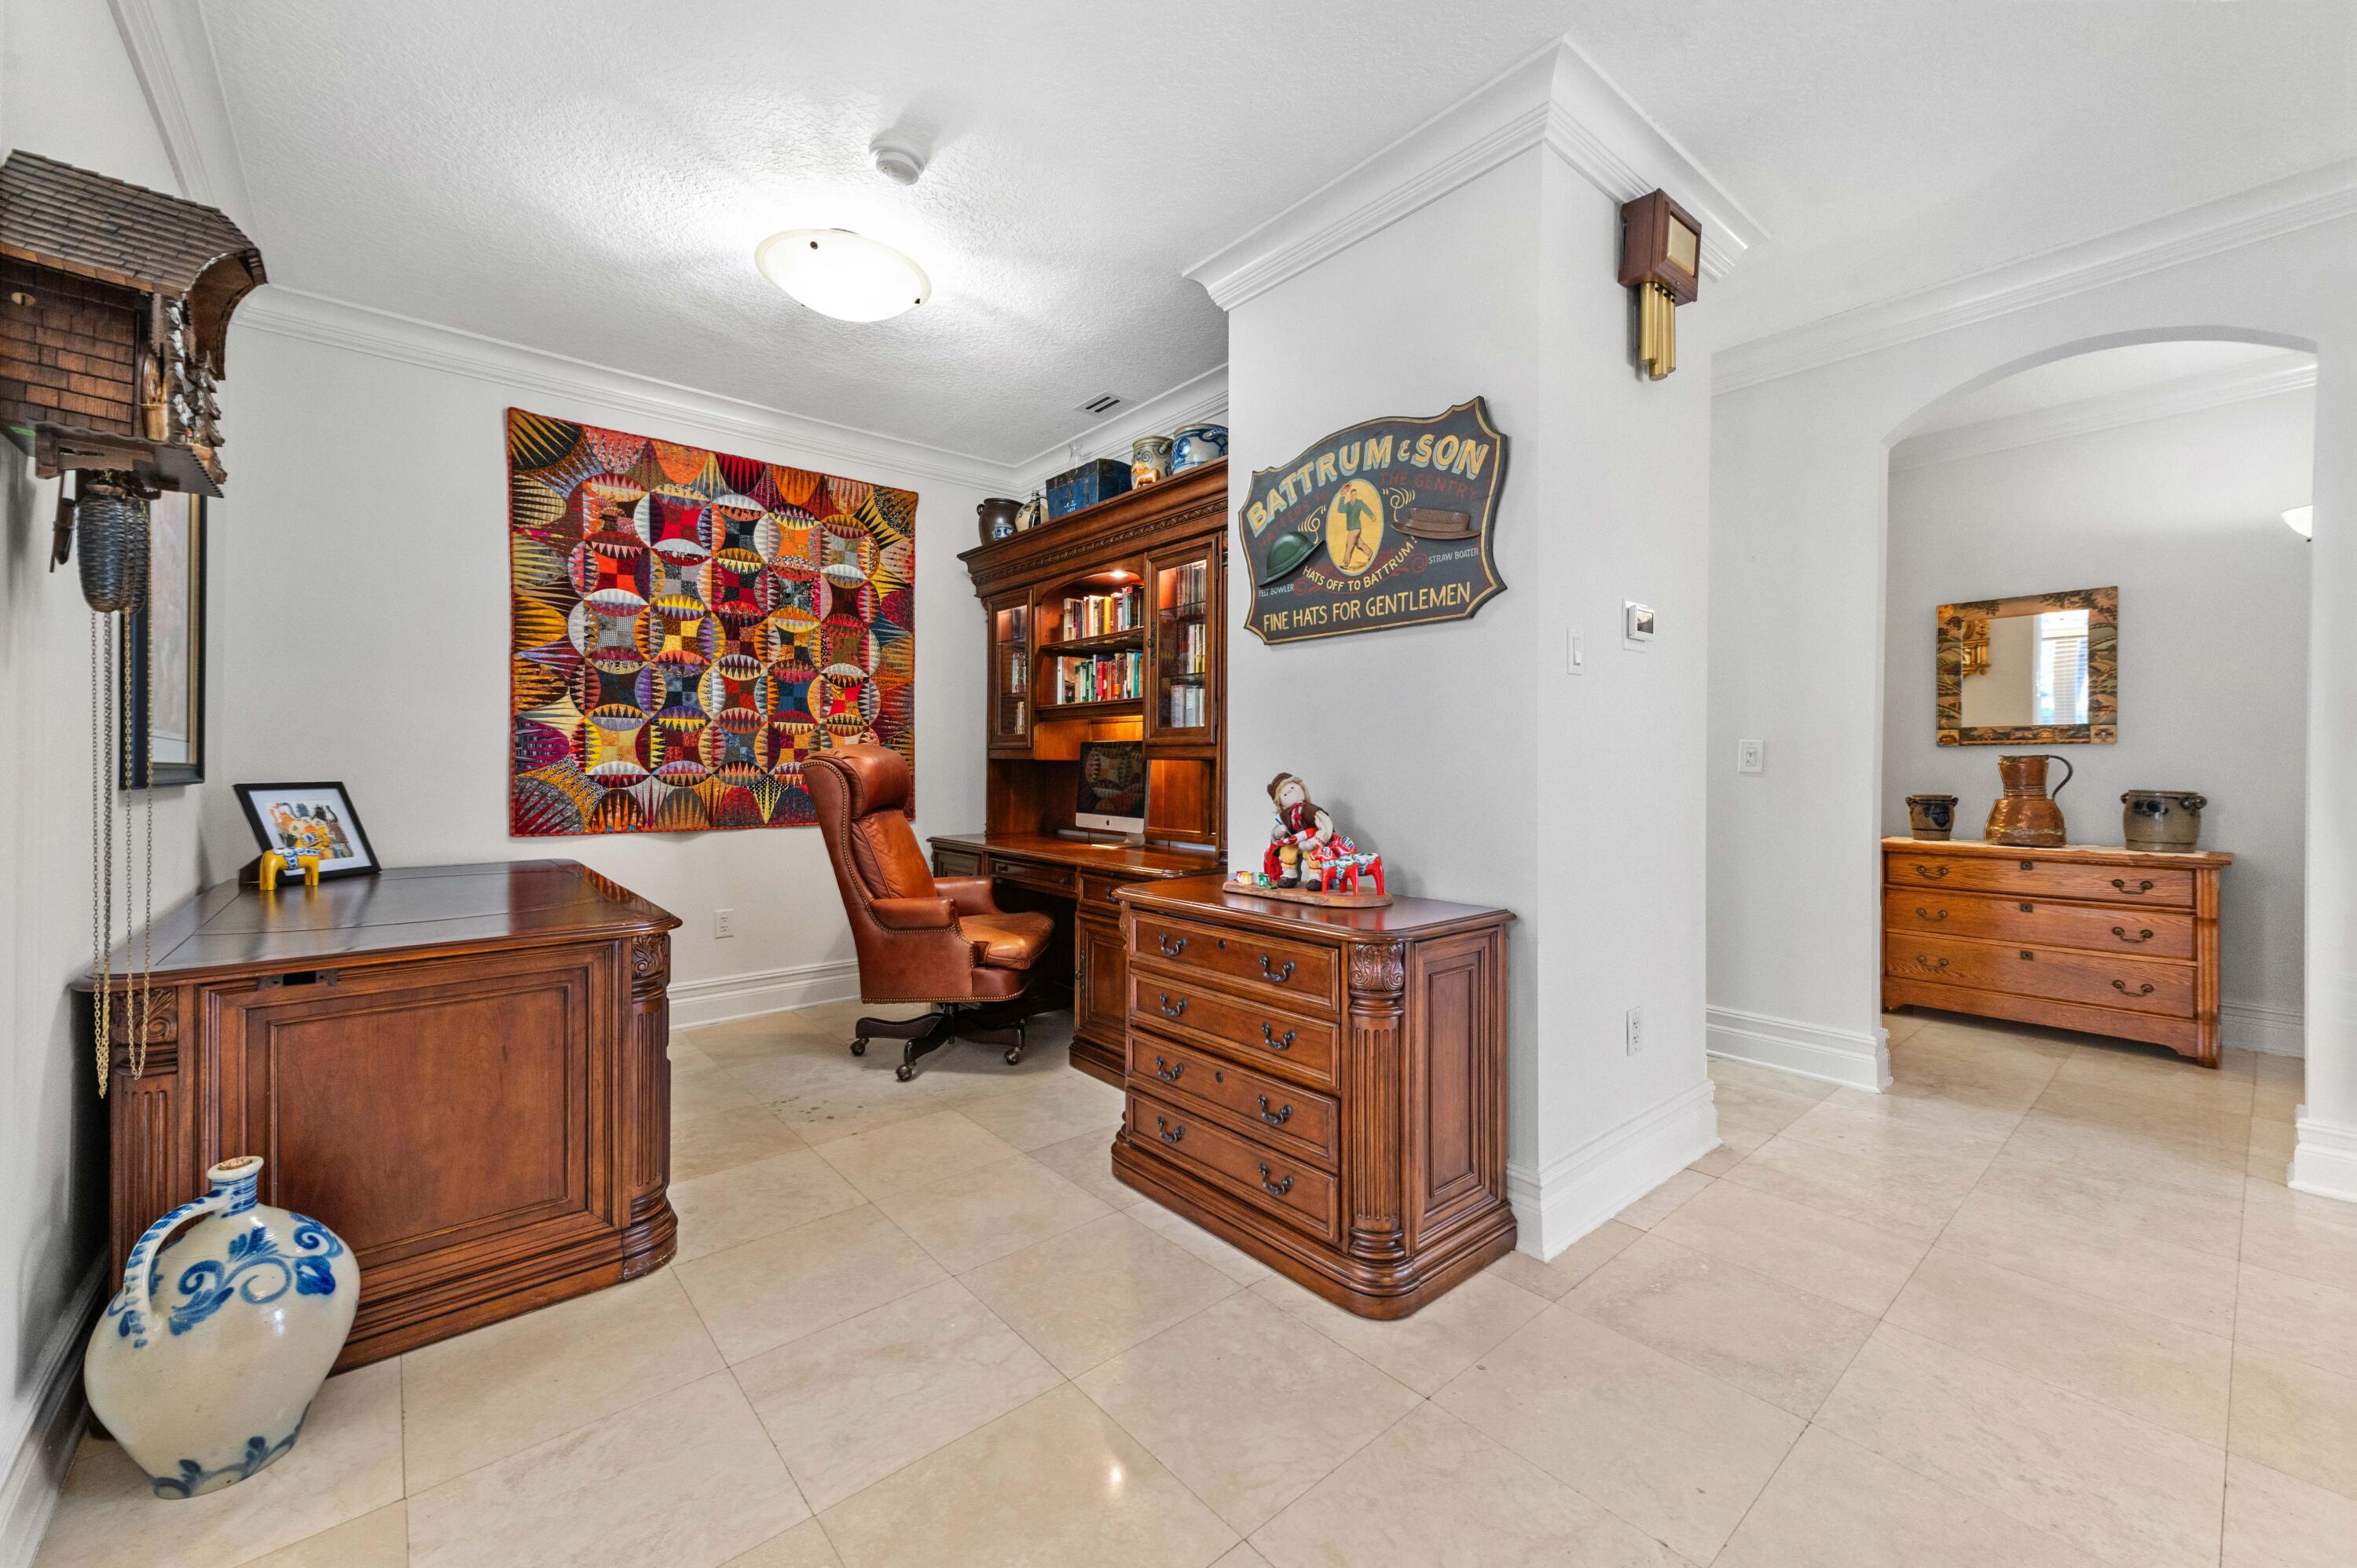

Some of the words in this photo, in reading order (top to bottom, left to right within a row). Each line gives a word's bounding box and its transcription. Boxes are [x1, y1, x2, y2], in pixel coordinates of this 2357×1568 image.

[1246, 434, 1393, 537] BATTRUM
[1410, 434, 1490, 481] SON
[1415, 474, 1478, 500] GENTRY
[1428, 552, 1453, 565] STRAW
[1454, 548, 1479, 560] BOATER
[1258, 588, 1270, 598] FELT
[1270, 584, 1295, 595] BOWLER
[1302, 566, 1324, 585] HATS
[1326, 579, 1343, 592] OFF
[1347, 580, 1361, 592] TO
[1263, 611, 1289, 632] FINE
[1293, 606, 1328, 626] HATS
[1332, 599, 1361, 623] FOR
[1365, 581, 1471, 617] GENTLEMEN
